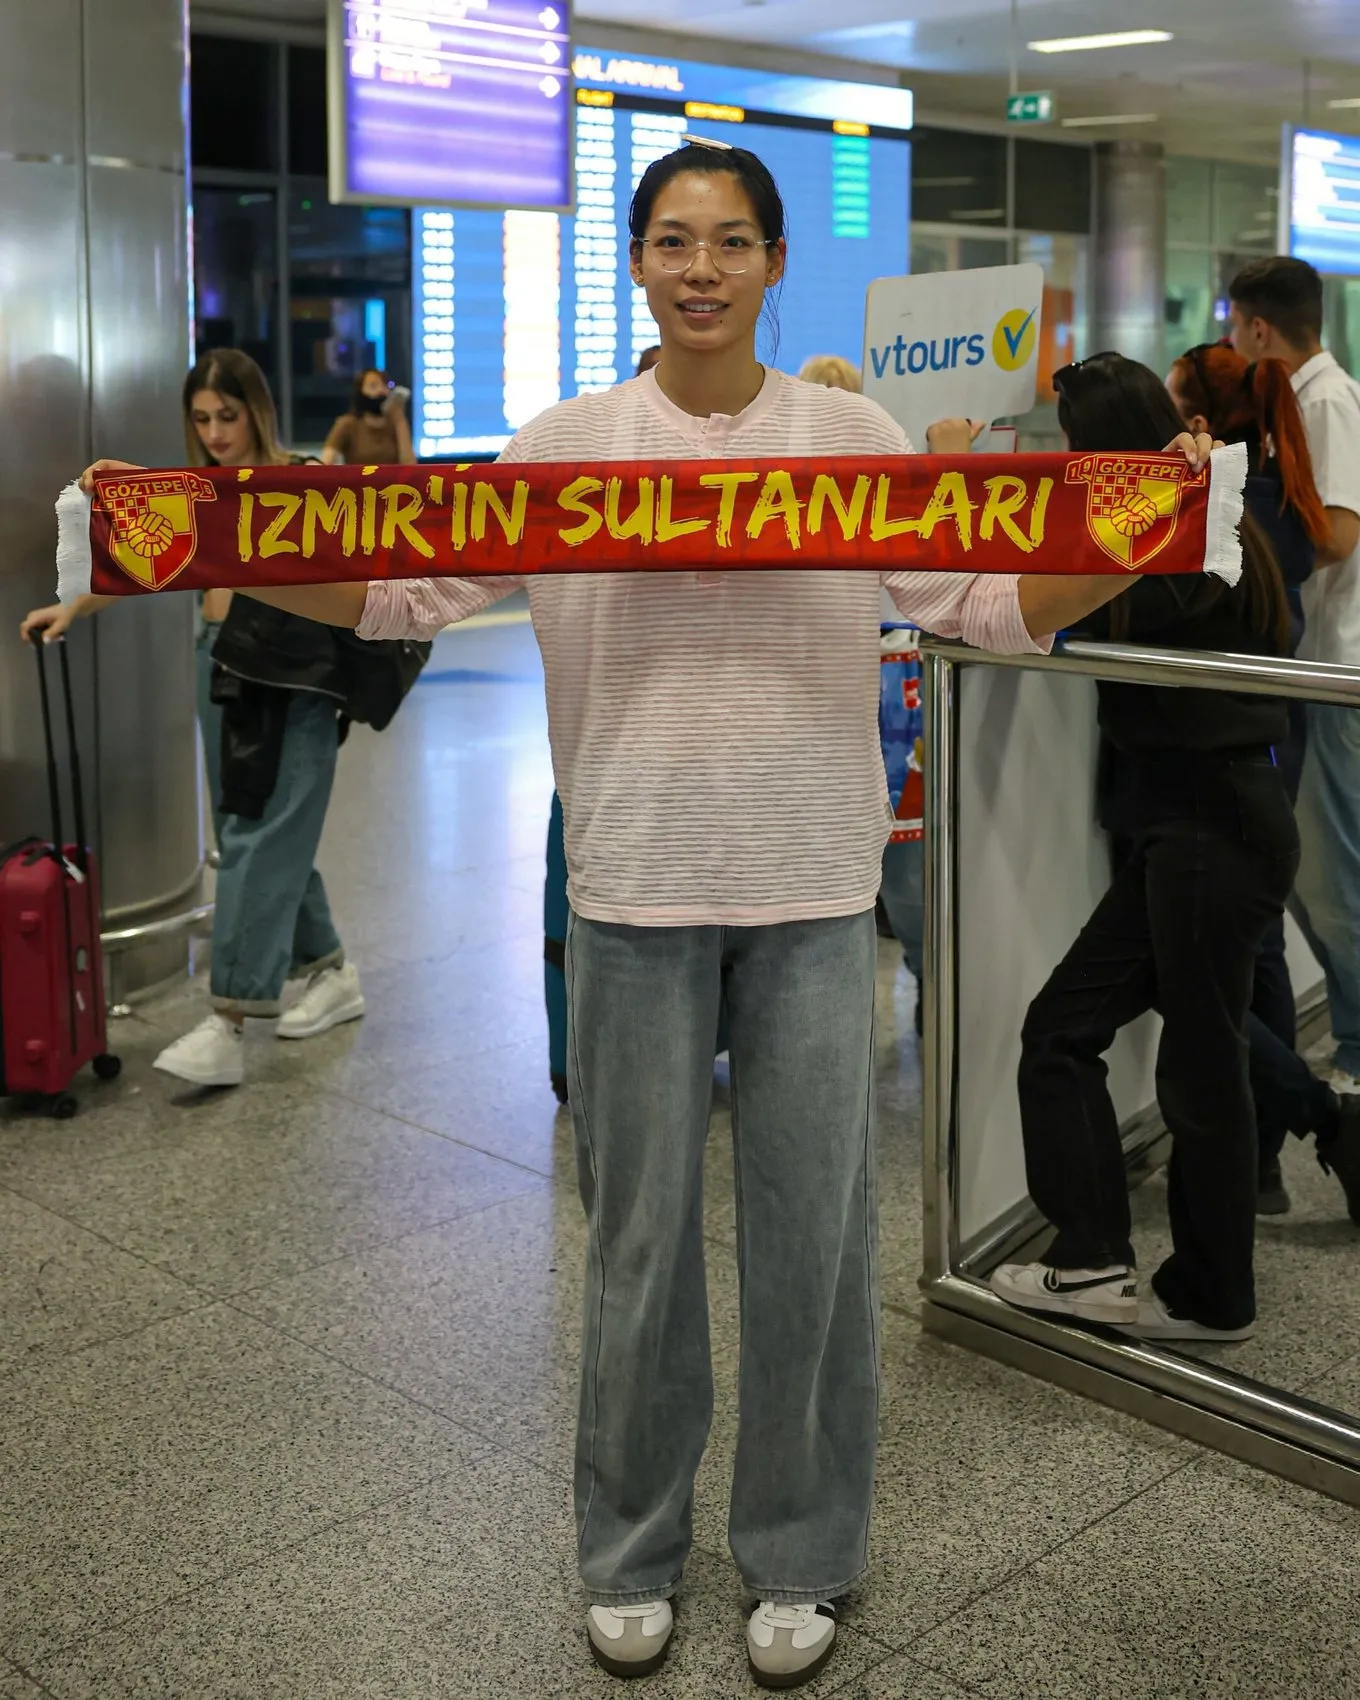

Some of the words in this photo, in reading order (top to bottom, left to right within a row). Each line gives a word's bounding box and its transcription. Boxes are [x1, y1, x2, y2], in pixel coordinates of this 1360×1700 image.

[869, 334, 986, 379] vtours
[1099, 459, 1182, 479] GÖZTEPE
[104, 480, 185, 499] GÖZTEPE
[237, 463, 530, 563] İZMİR'İN
[557, 469, 1055, 554] SULTANLARI
